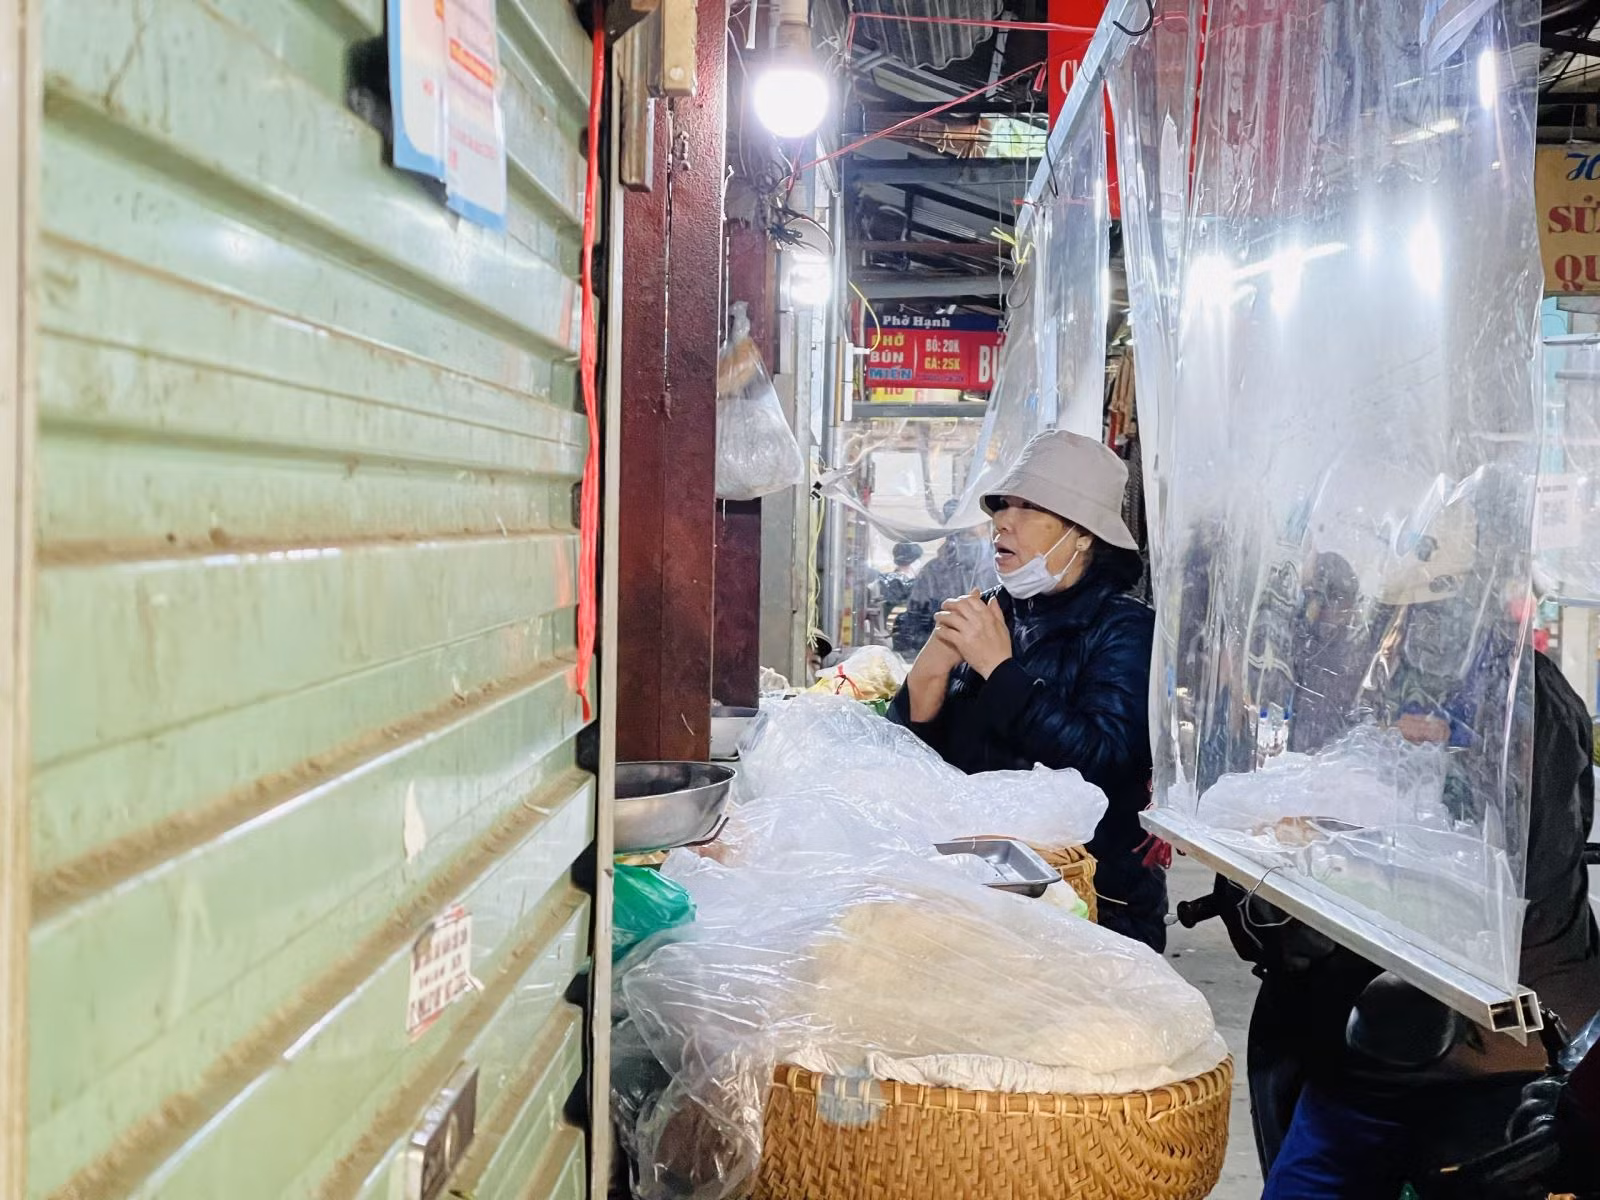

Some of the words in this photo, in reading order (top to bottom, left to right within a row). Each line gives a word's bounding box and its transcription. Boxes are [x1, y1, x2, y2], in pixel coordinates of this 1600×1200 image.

[882, 314, 910, 326] Phở
[913, 315, 951, 329] Hạnh
[871, 332, 905, 347] PHỞ
[870, 349, 904, 363] BÚN
[942, 357, 960, 370] 25K
[978, 337, 1003, 383] BÚ
